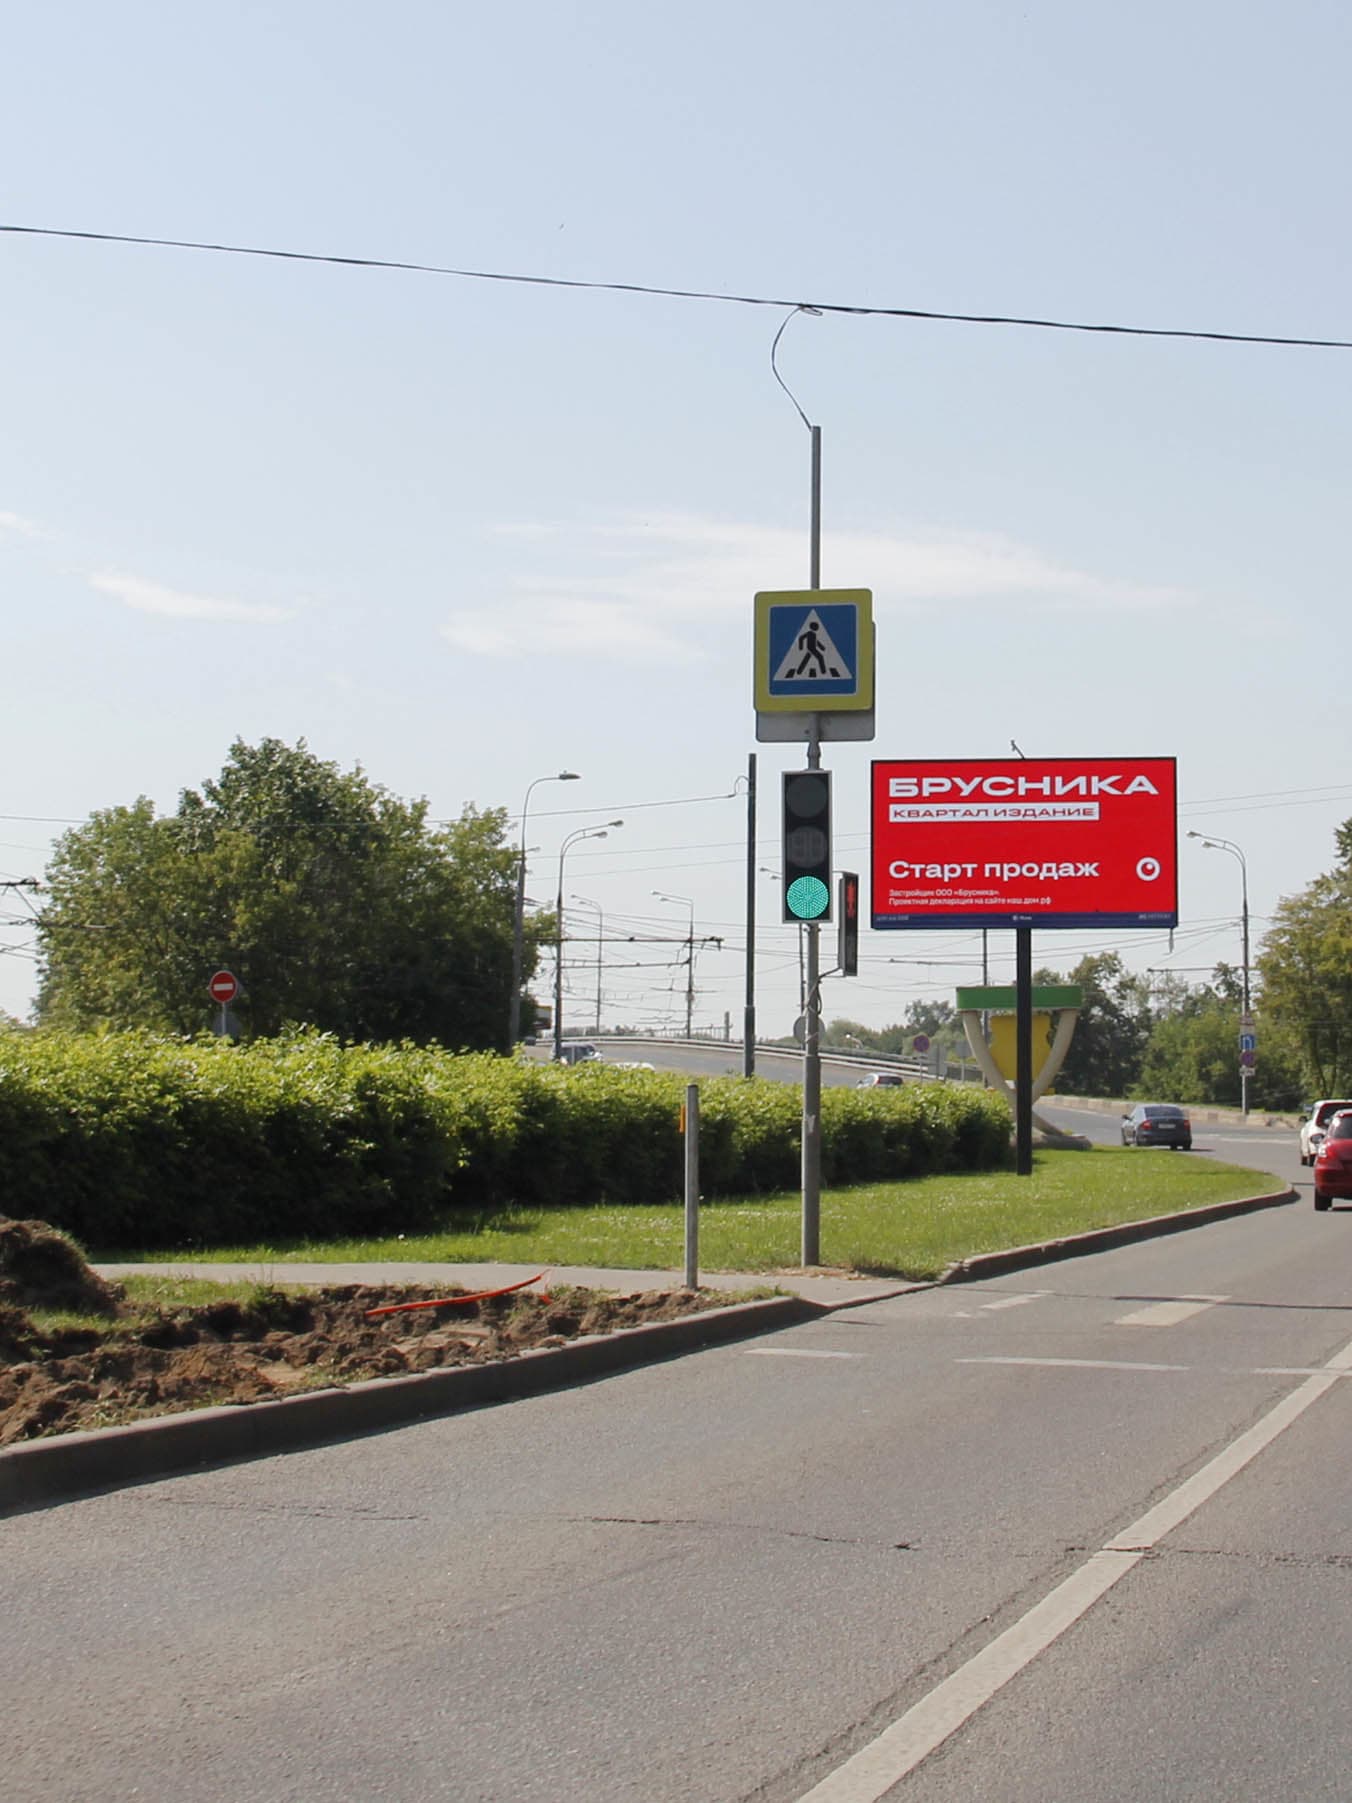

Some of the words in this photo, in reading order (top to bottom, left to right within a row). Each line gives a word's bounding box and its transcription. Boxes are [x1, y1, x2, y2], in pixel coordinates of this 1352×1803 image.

[889, 775, 1159, 798] БРУСНИКА
[894, 807, 989, 819] КВАРТАЛ
[993, 807, 1095, 819] ИЗДАНИЕ
[888, 860, 978, 882] Старт
[984, 862, 1100, 882] продаж
